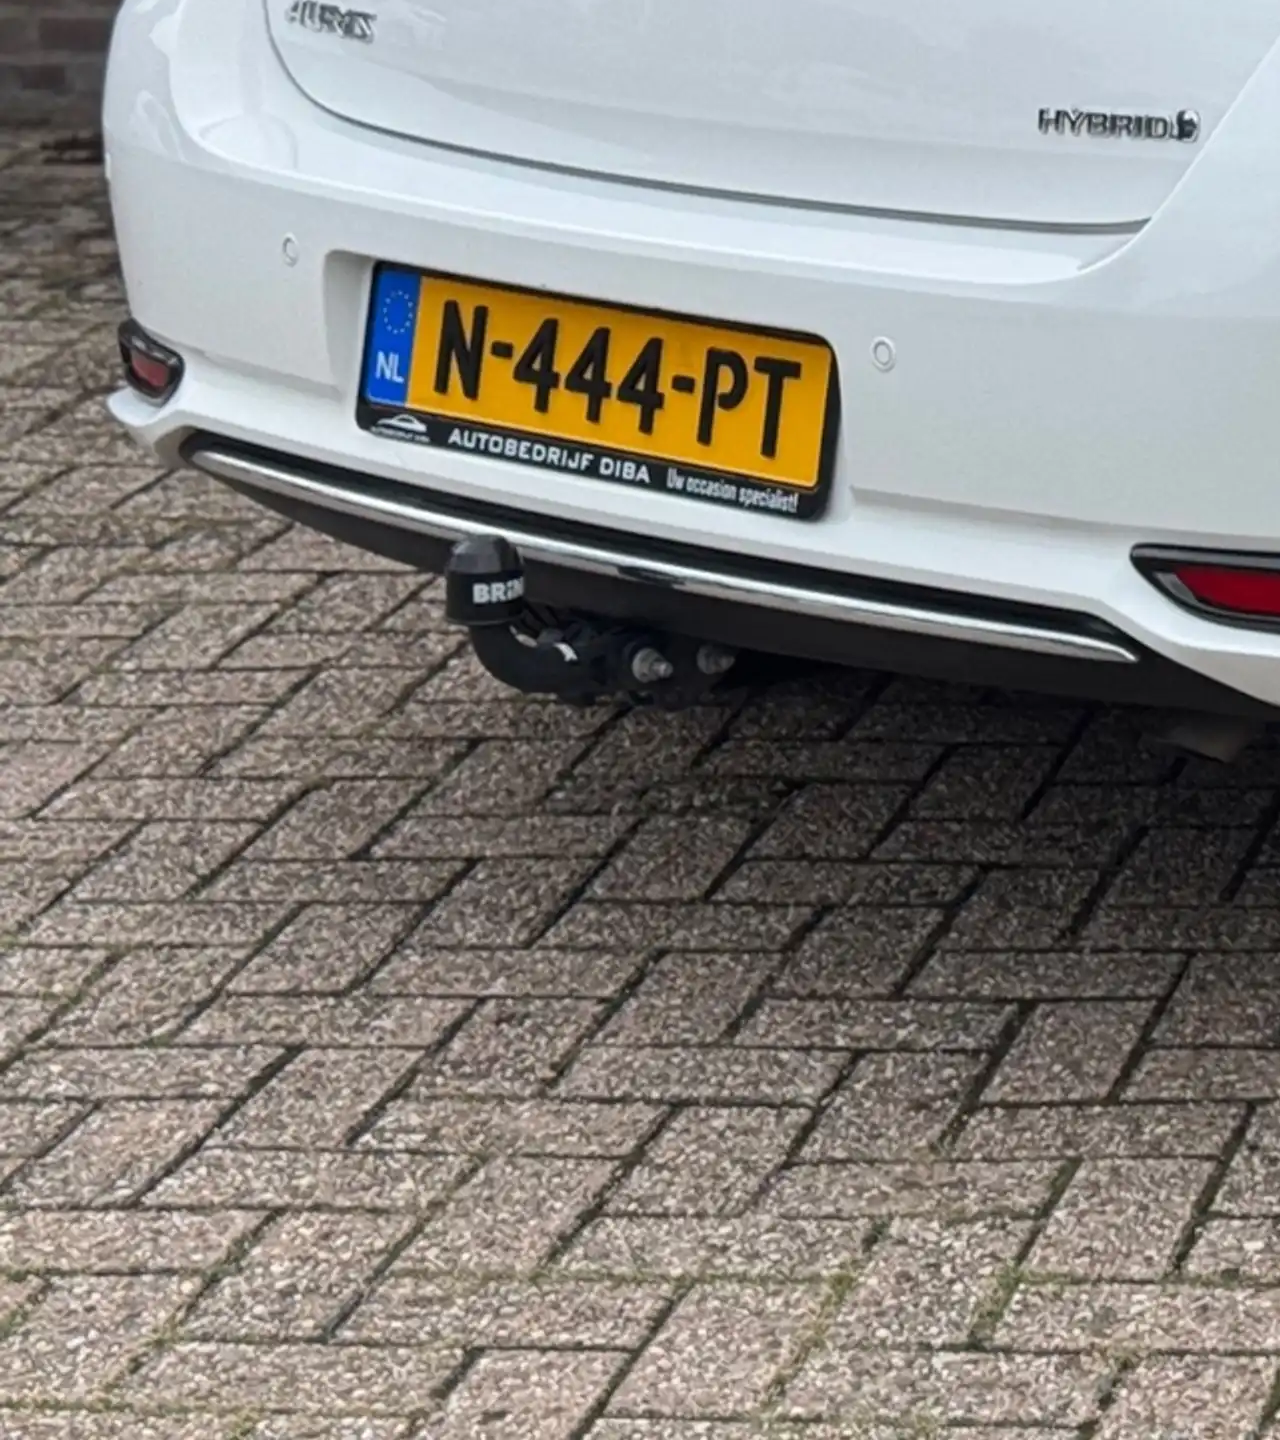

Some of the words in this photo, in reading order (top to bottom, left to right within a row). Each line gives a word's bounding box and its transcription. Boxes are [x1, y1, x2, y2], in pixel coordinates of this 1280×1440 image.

[1038, 107, 1169, 141] HYBRID
[375, 350, 405, 384] NL
[433, 299, 802, 459] N-444-PT
[448, 427, 593, 471] AUTOBEDRIJF
[599, 458, 651, 484] DIBA
[666, 466, 685, 490] Uw
[686, 475, 737, 501] occasion
